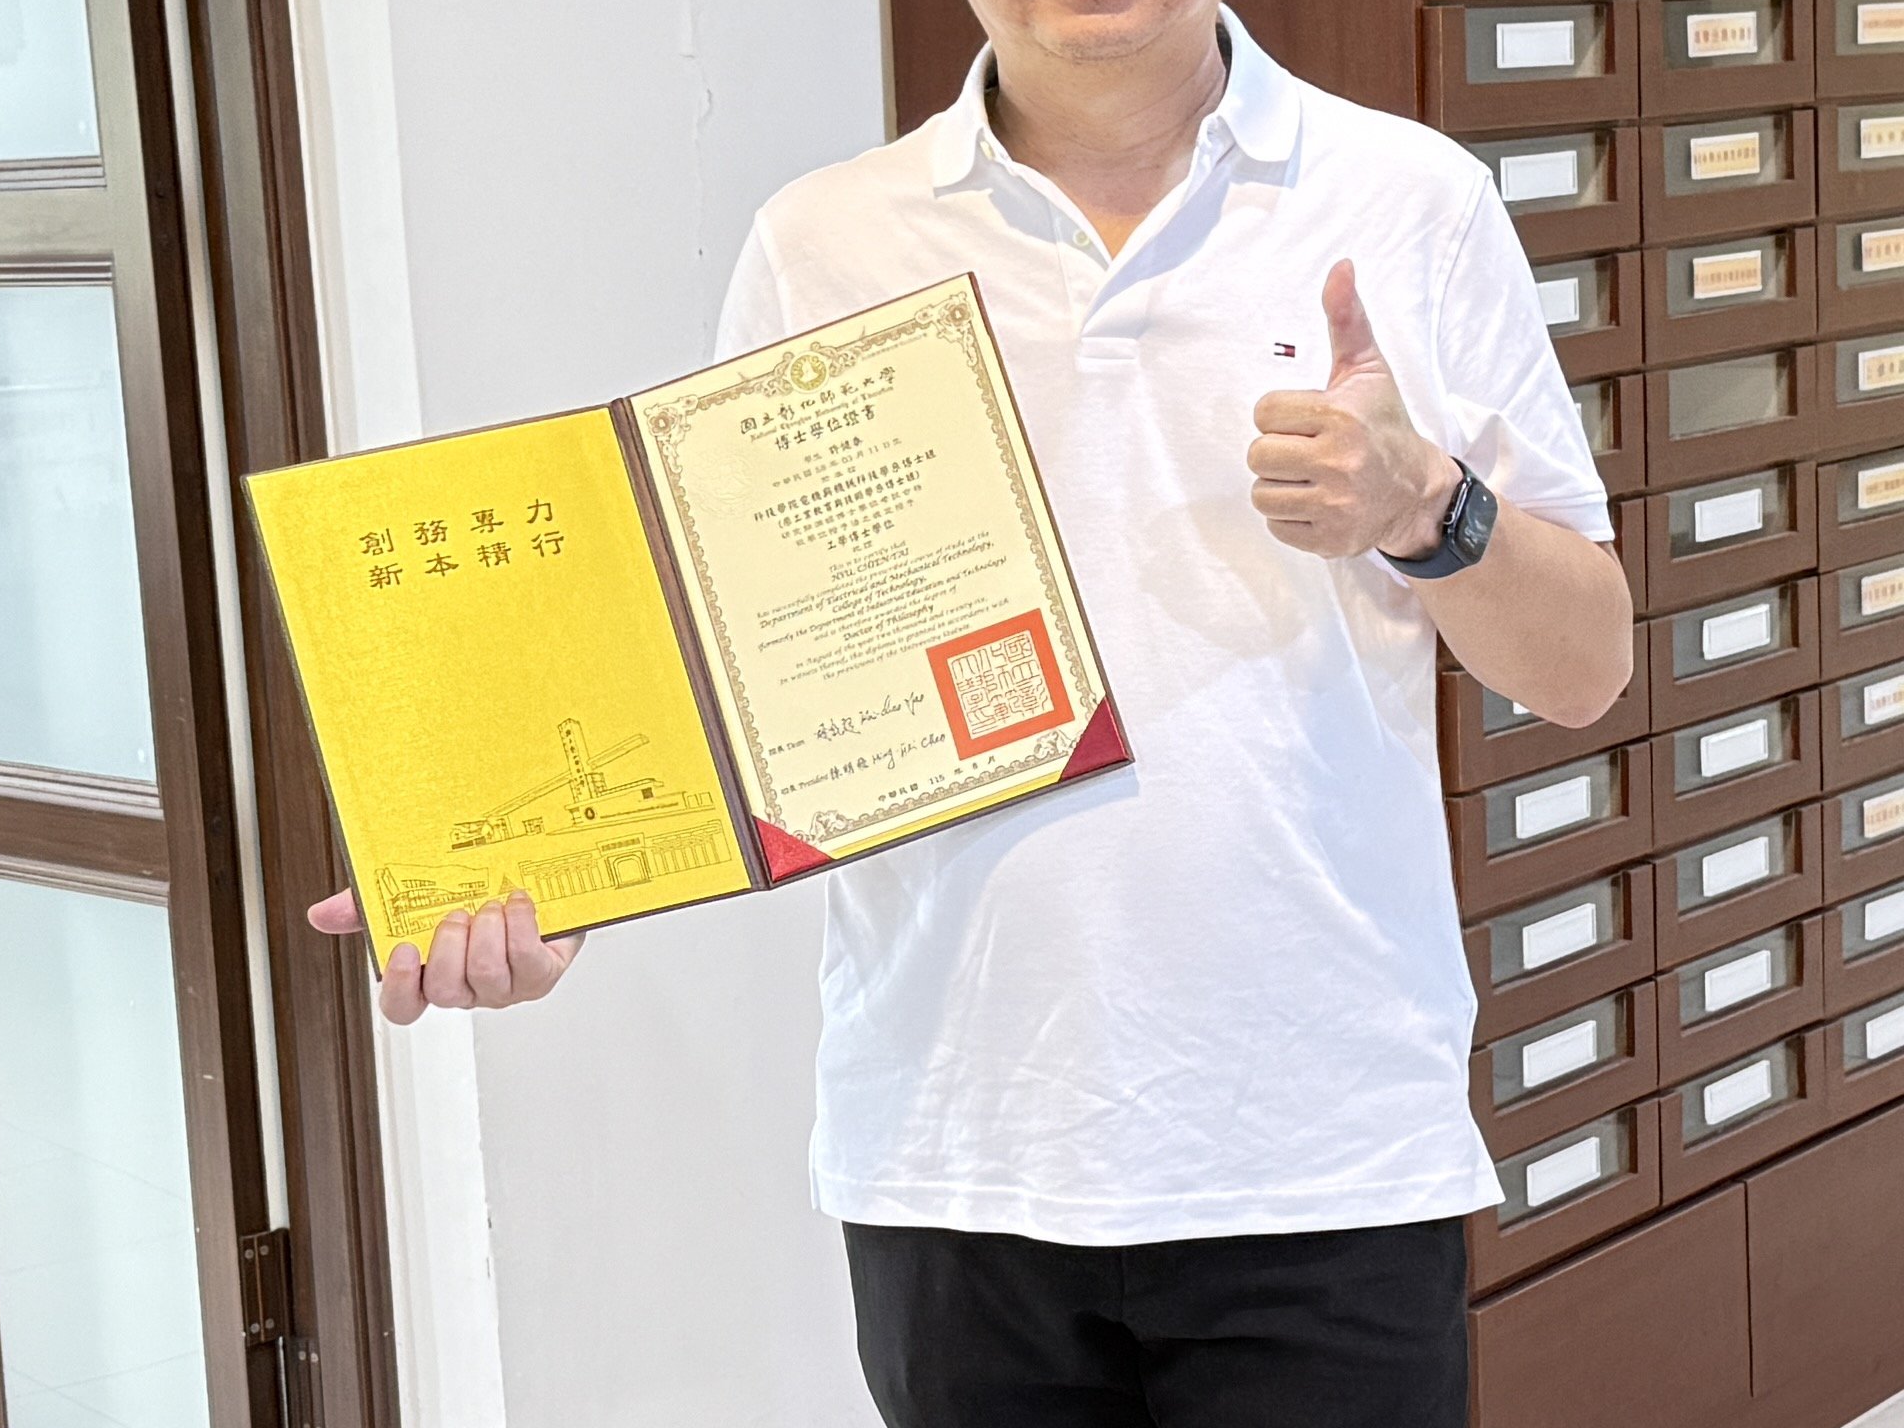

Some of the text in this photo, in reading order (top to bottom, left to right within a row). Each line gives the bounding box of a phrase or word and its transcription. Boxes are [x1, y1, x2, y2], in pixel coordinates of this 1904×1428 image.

[774, 404, 875, 451] 博士學位證書
